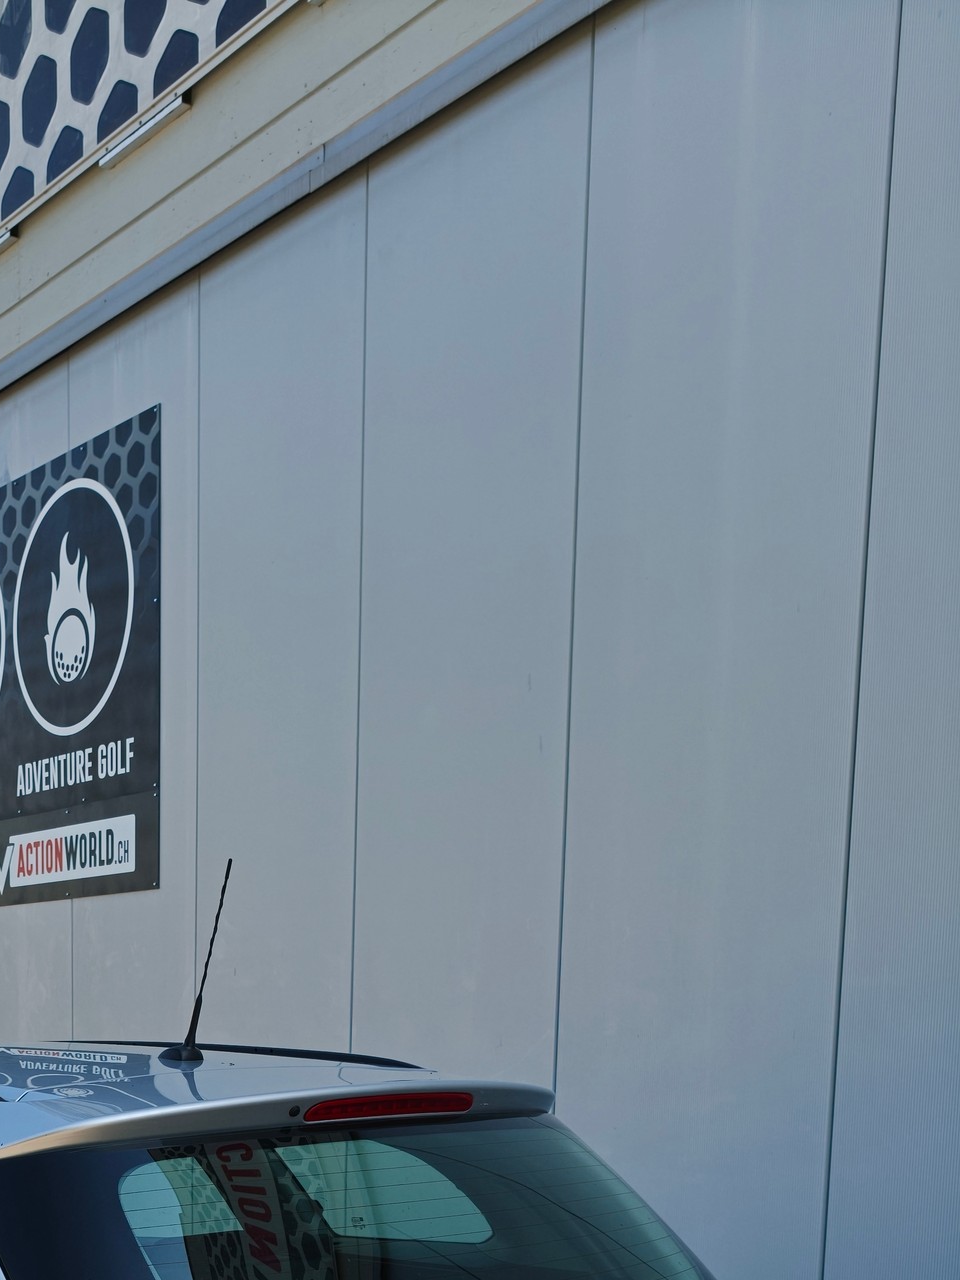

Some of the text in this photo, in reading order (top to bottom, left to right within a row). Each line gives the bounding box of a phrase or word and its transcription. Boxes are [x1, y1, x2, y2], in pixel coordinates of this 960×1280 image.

[17, 737, 135, 797] ADVENTURE GOLF
[17, 828, 129, 878] ACTIONWORLD.CH
